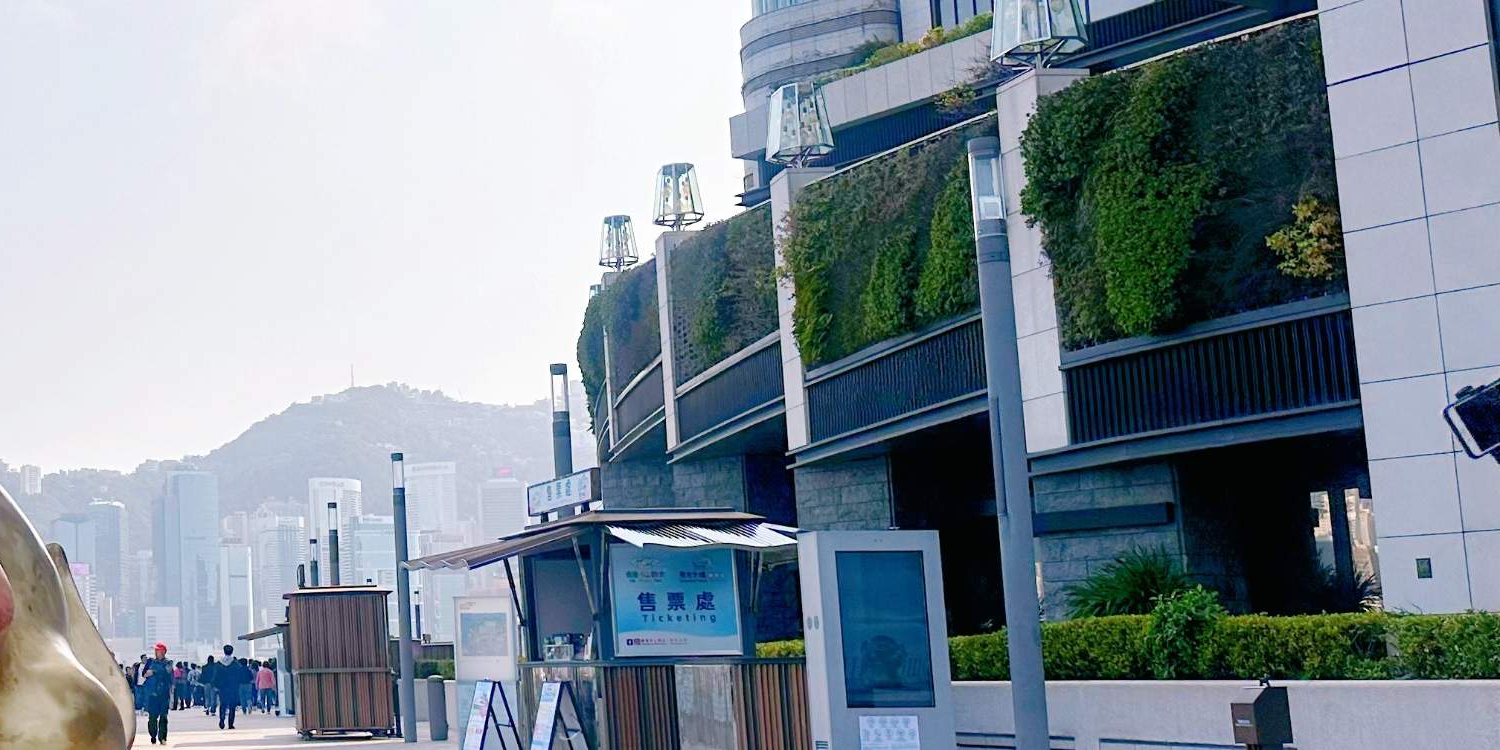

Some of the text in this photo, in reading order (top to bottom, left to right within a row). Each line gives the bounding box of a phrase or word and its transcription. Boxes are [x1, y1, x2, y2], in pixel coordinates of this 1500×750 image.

[637, 591, 716, 612] 售票處
[642, 613, 717, 623] Ticketing
